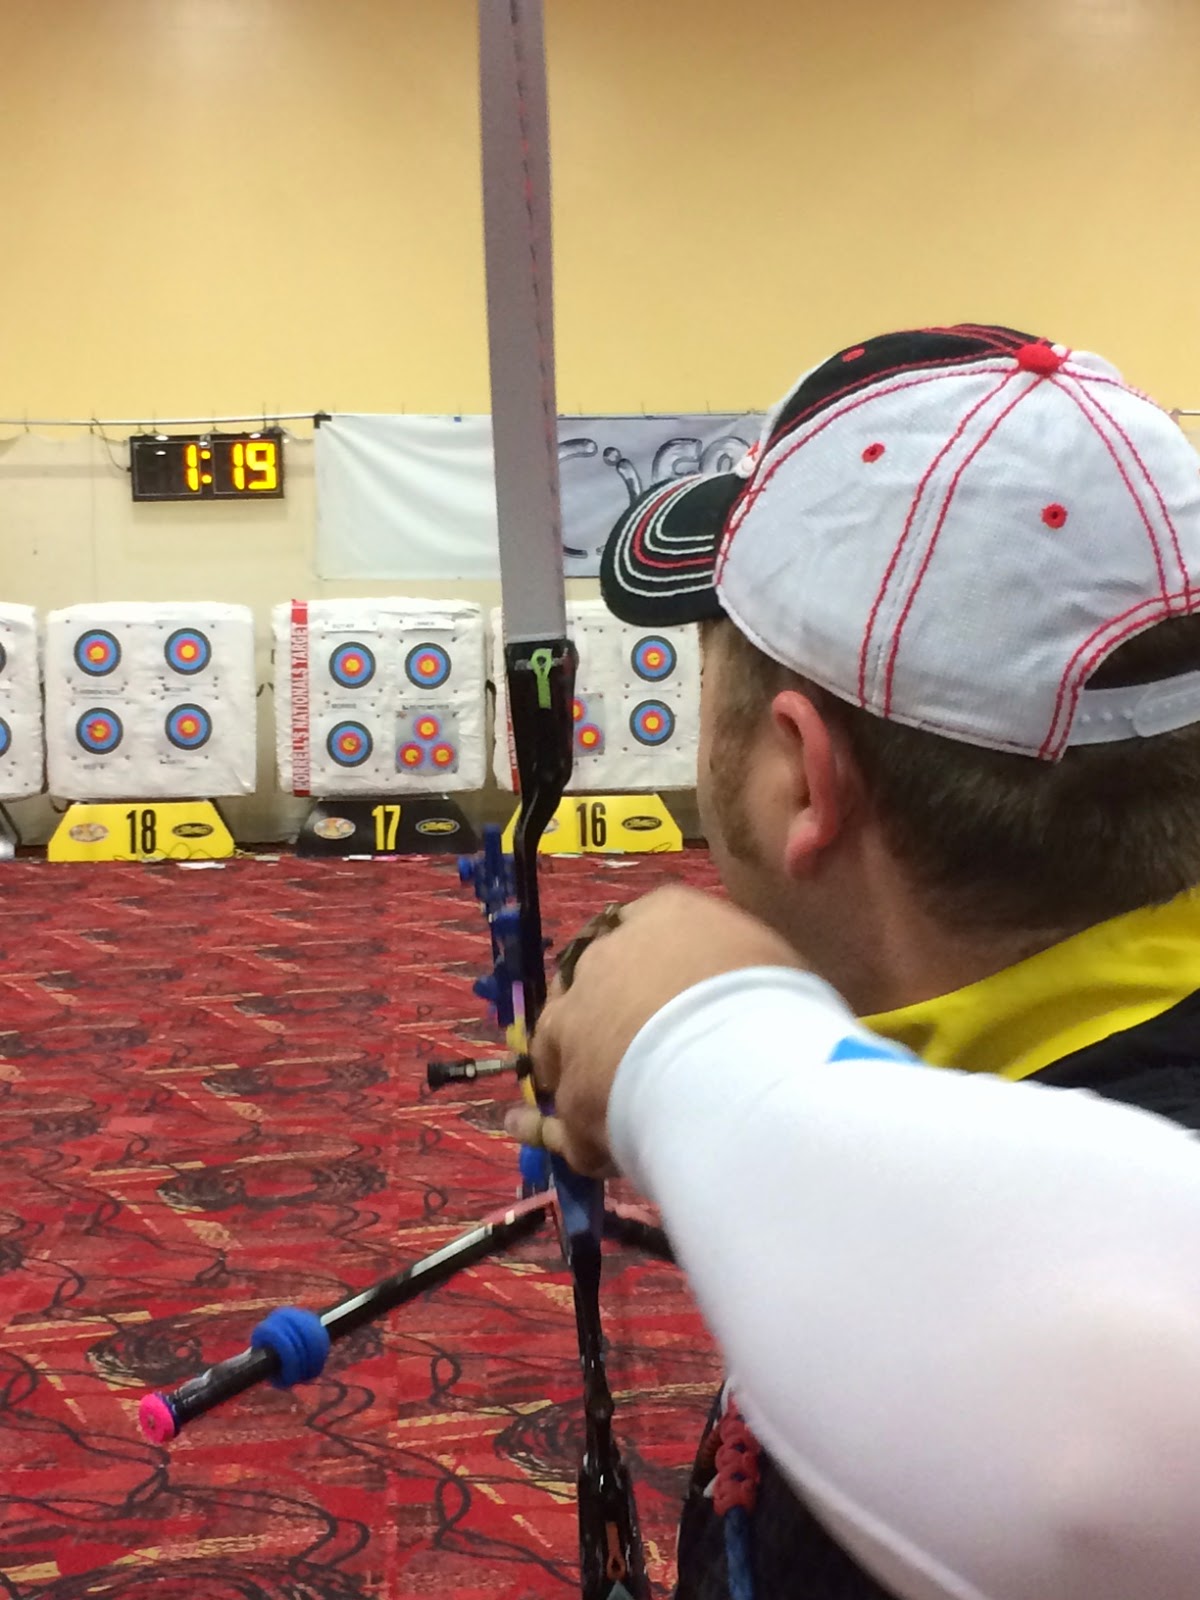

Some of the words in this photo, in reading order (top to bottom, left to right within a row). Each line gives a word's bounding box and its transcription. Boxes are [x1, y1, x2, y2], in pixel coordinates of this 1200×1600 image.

[186, 442, 277, 490] 1:19
[291, 622, 308, 664] TARGET
[292, 668, 310, 728] NATIONALS
[126, 809, 156, 854] 18
[371, 805, 401, 850] 17
[576, 802, 606, 847] 16
